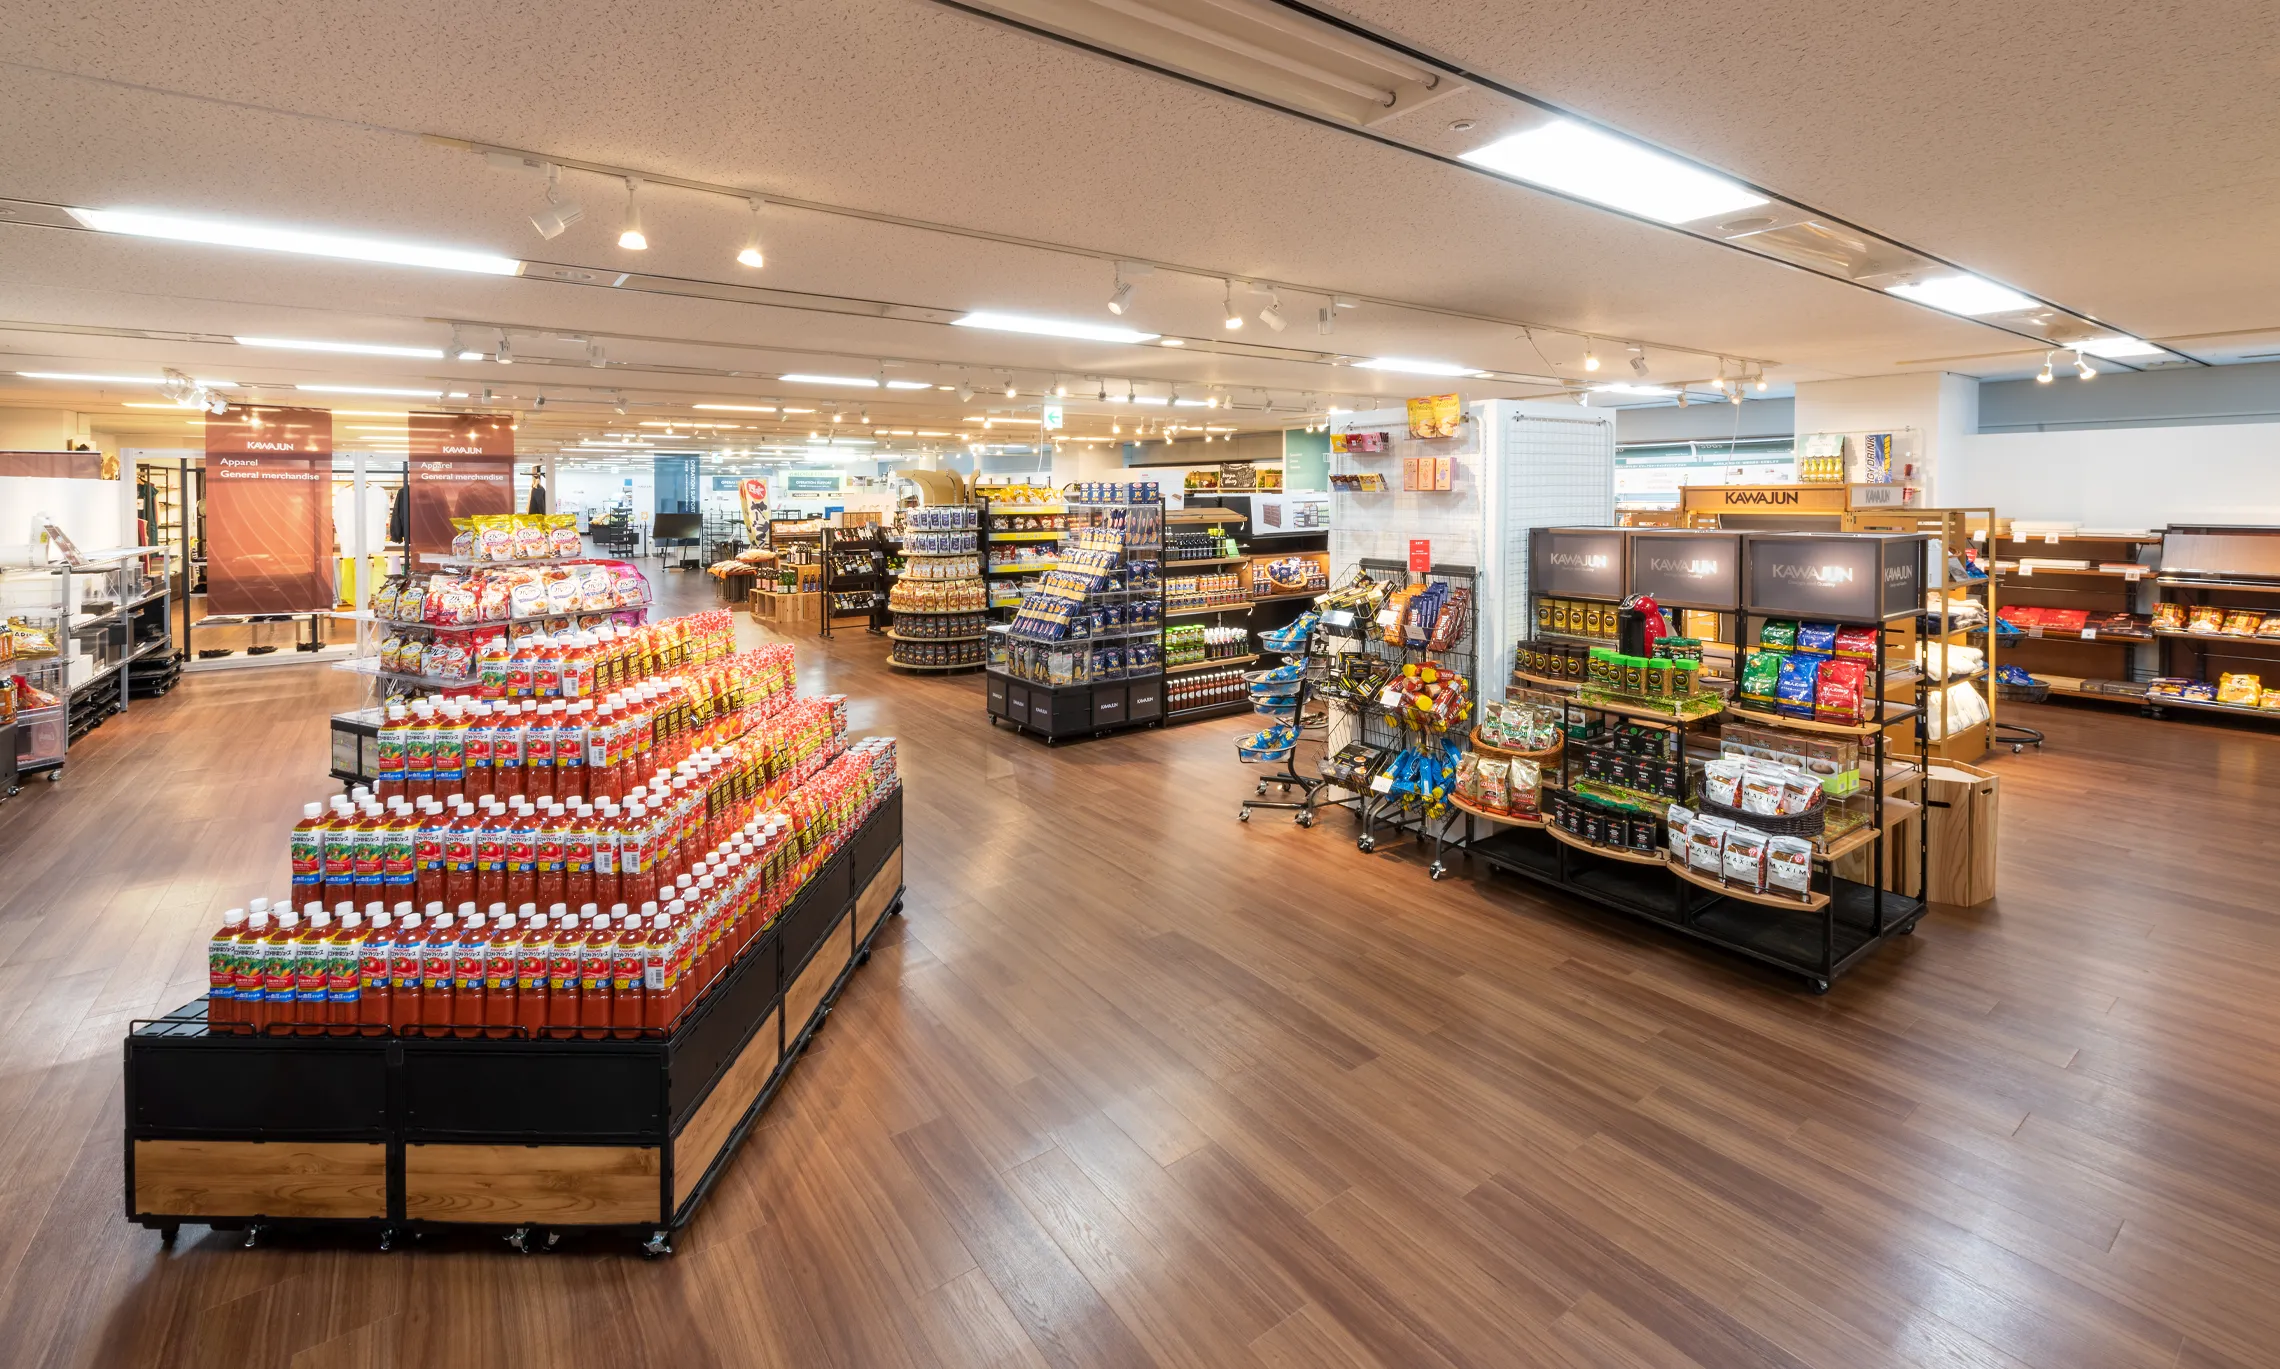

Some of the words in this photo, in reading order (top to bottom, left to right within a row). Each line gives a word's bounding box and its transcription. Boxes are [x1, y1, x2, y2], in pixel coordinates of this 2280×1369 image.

[247, 441, 294, 451] KAWAJUN
[443, 446, 482, 454] KAWAJUN
[1867, 436, 1876, 467] DRINK
[220, 458, 258, 467] Apparel
[220, 470, 259, 479] General
[261, 472, 320, 481] merchandise
[1725, 491, 1798, 504] KAWAJUN
[1550, 553, 1608, 569] KAWAJUN
[1651, 558, 1717, 574] KAWAJUN
[1772, 563, 1853, 582] KAWAJUN
[1884, 564, 1913, 582] KAWAJUN
[1744, 790, 1779, 805] MAXIM
[1670, 832, 1686, 844] AXIM
[1689, 844, 1720, 859] MAXIM
[1723, 854, 1758, 868] MAXIM
[1768, 862, 1807, 876] MAXIM
